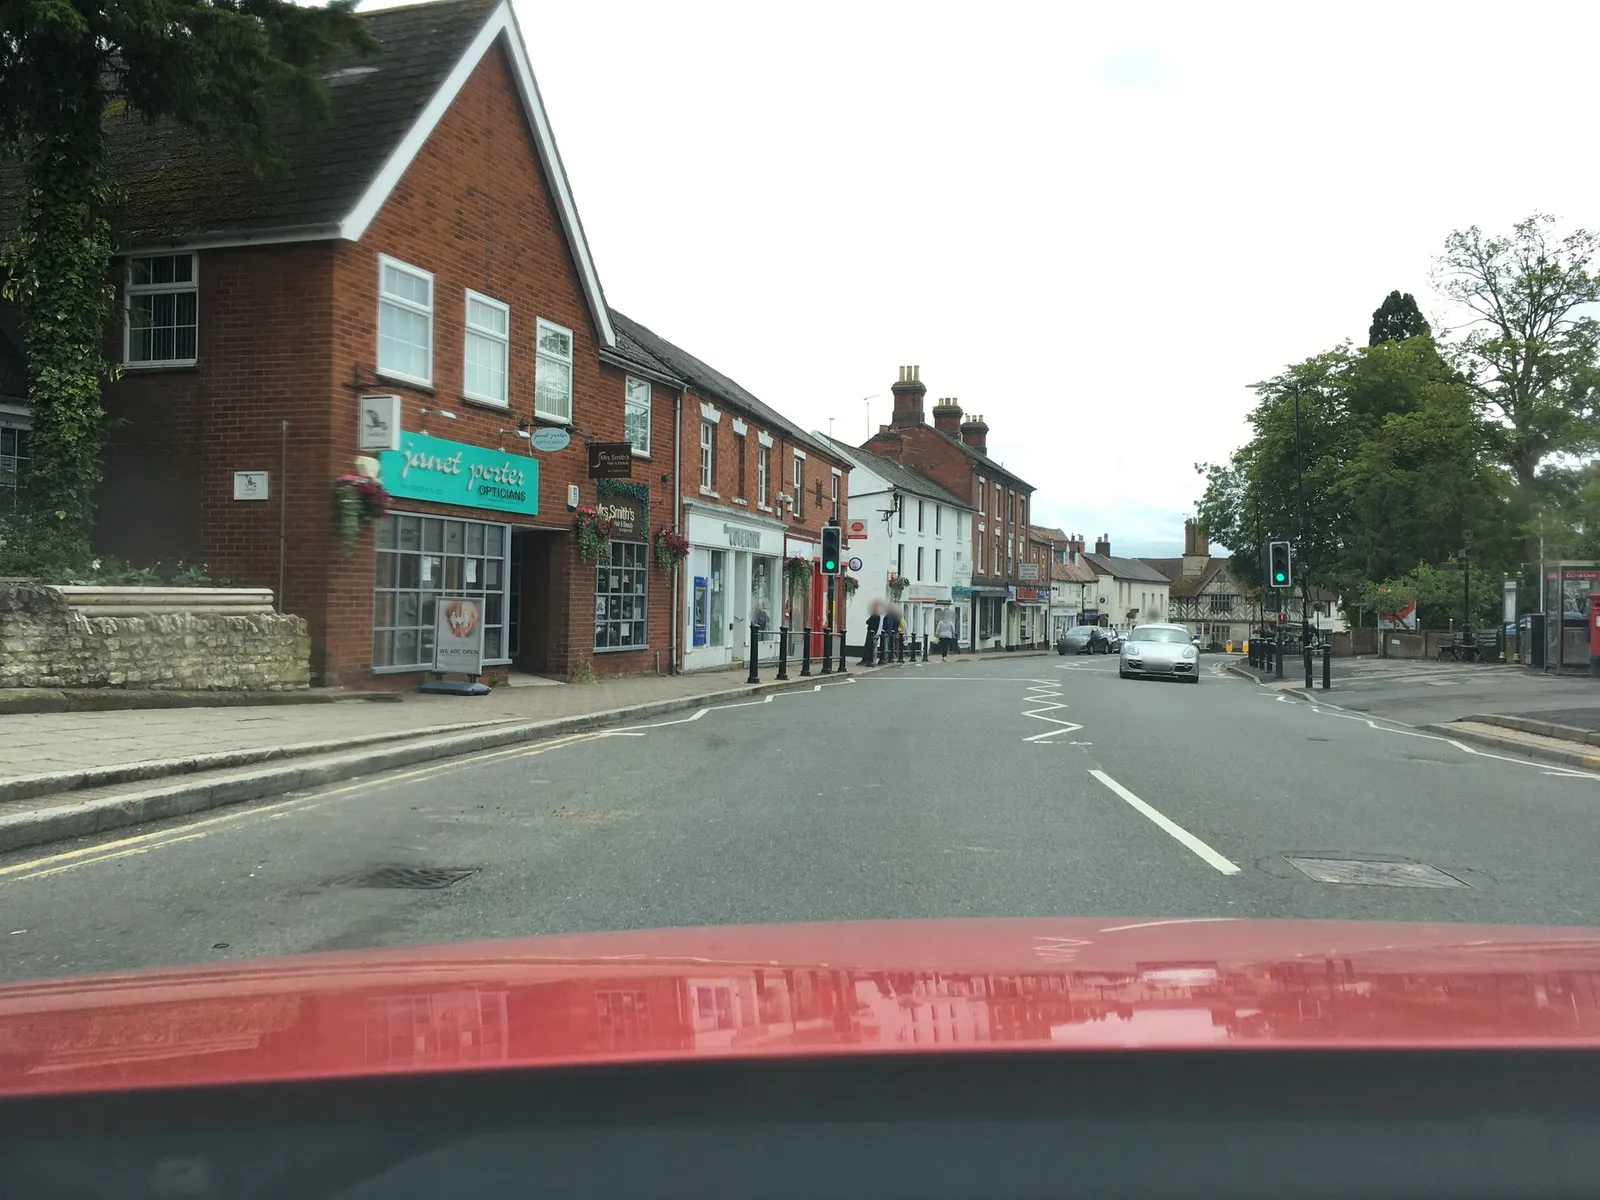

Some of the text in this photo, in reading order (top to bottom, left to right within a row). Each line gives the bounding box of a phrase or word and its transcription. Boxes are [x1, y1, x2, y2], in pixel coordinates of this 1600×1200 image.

[402, 442, 525, 491] janet porter
[478, 485, 526, 502] OPTICIANS
[610, 504, 635, 522] Smith's
